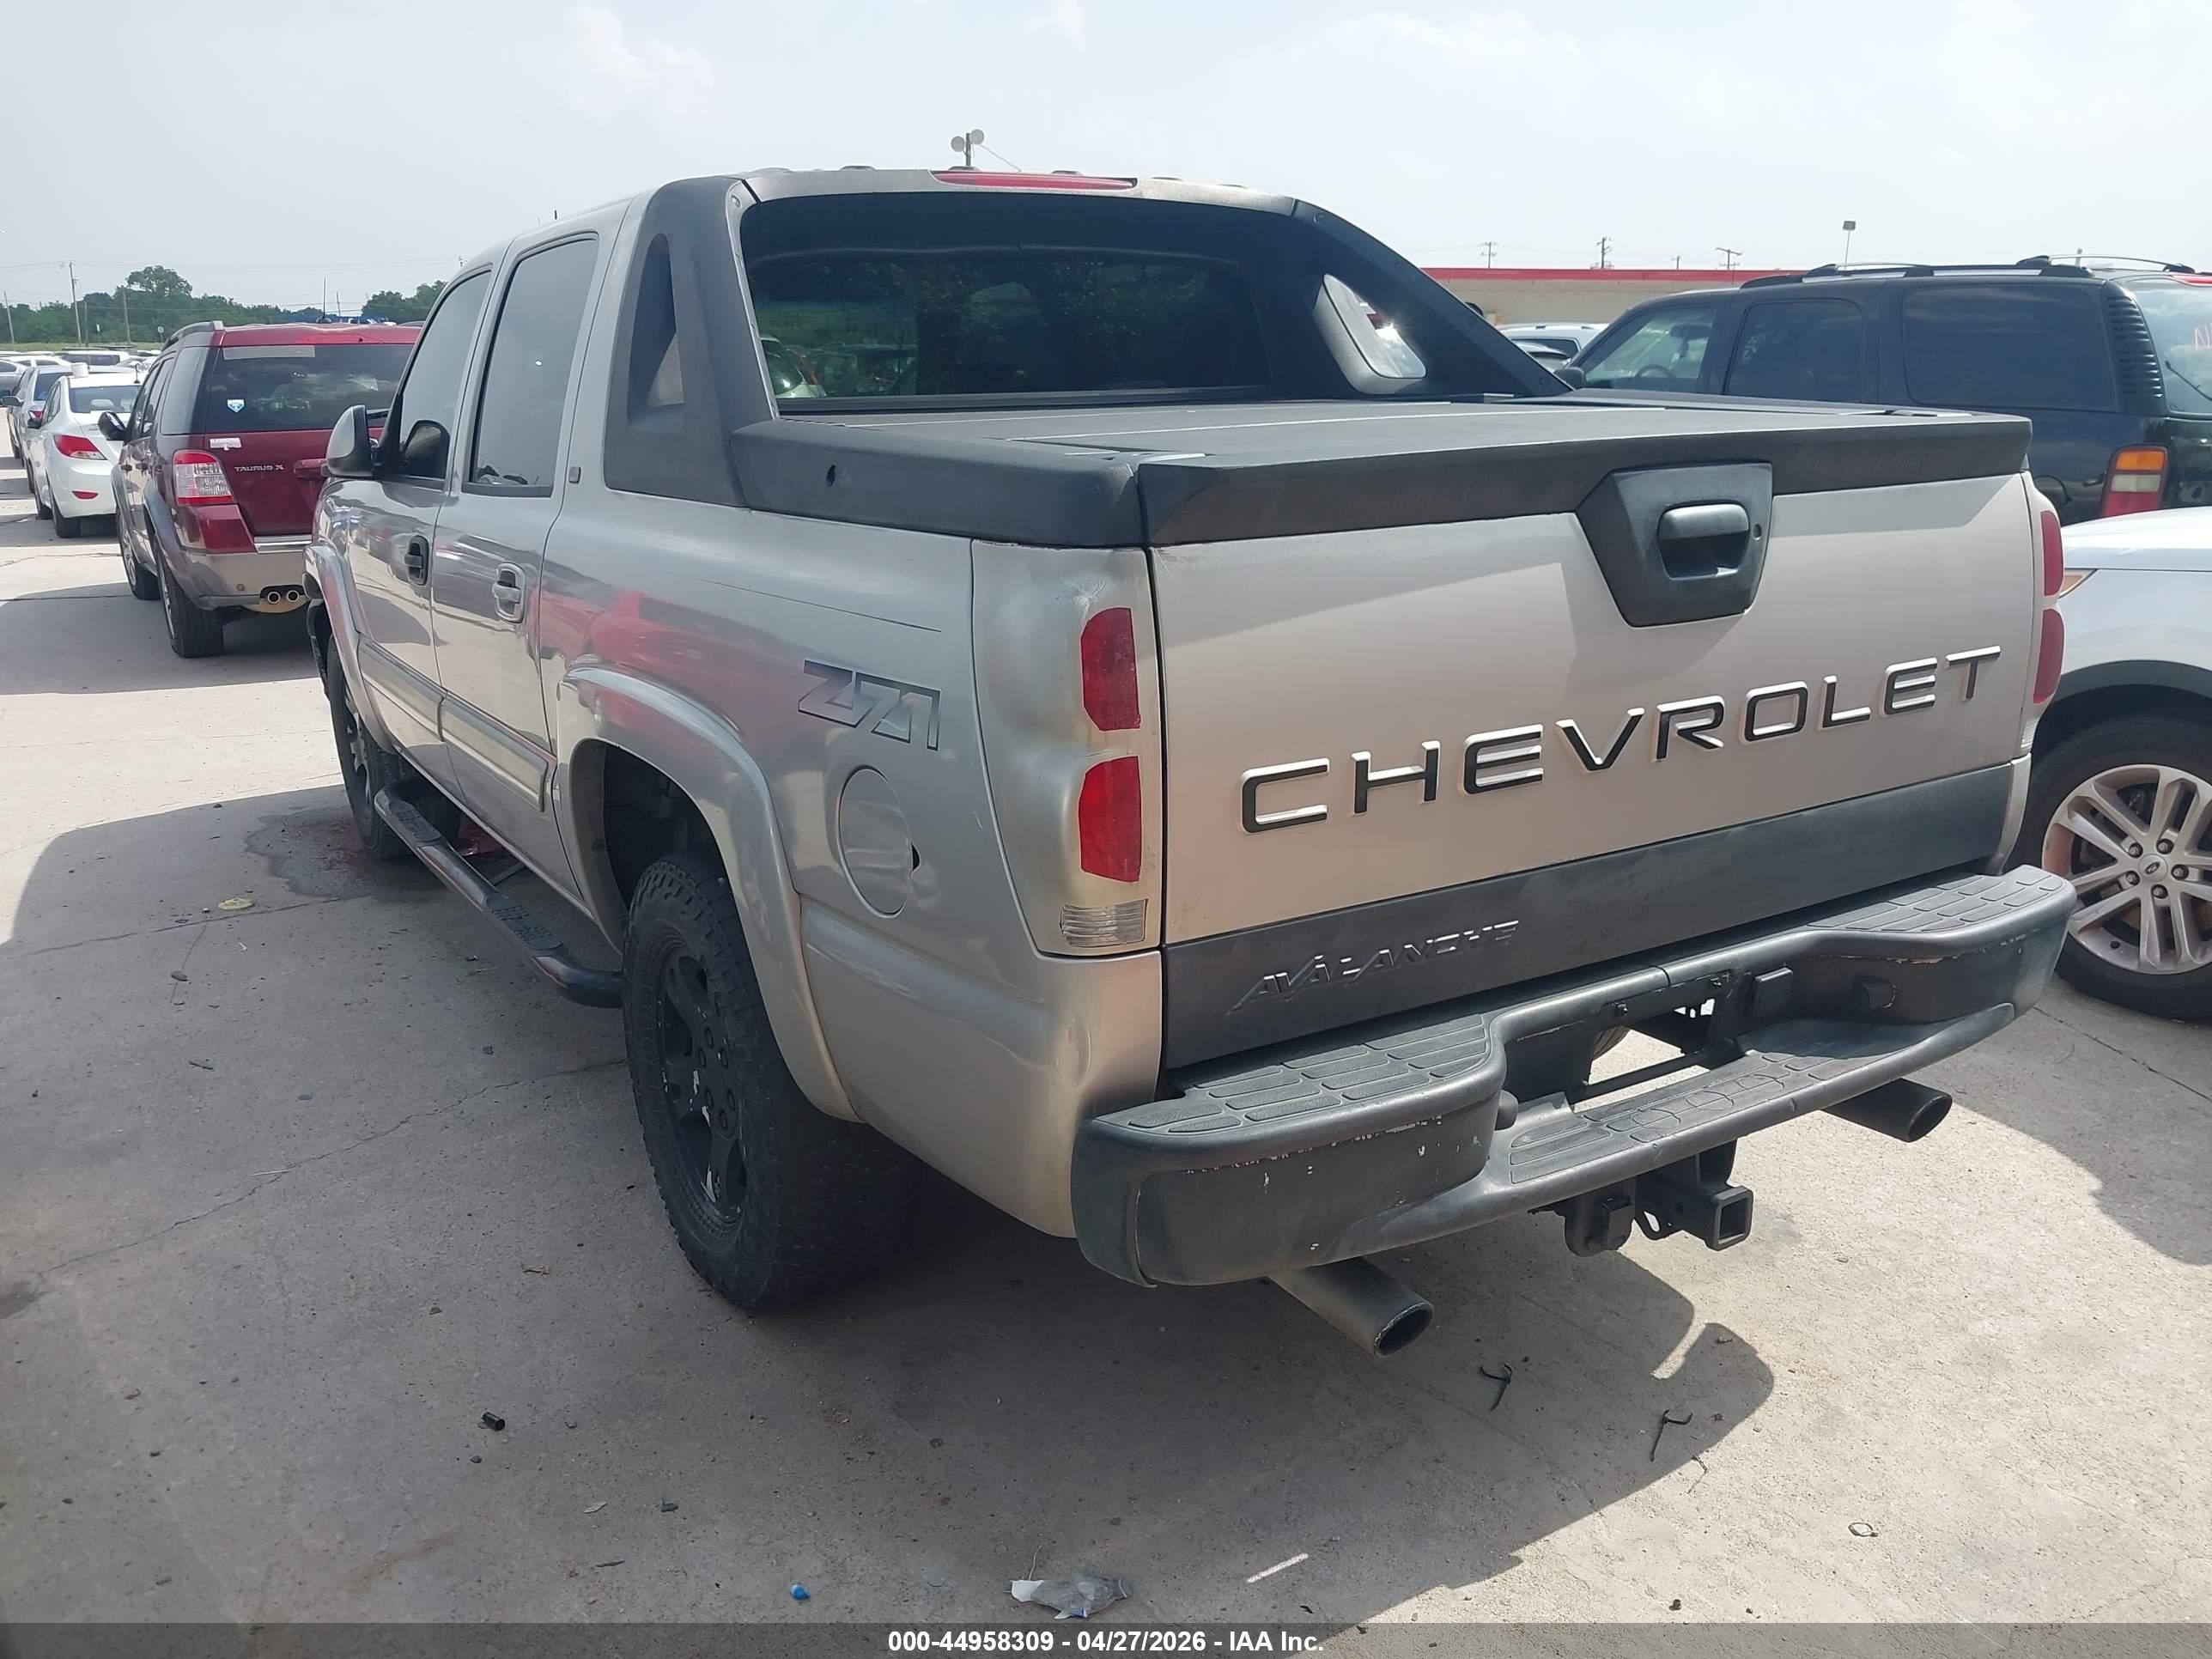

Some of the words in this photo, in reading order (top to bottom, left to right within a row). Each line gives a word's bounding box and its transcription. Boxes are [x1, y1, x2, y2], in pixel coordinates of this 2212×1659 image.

[797, 659, 942, 751] Z71
[1239, 645, 2002, 836] CHEVROLET
[1227, 920, 1519, 1017] AVALANCHE
